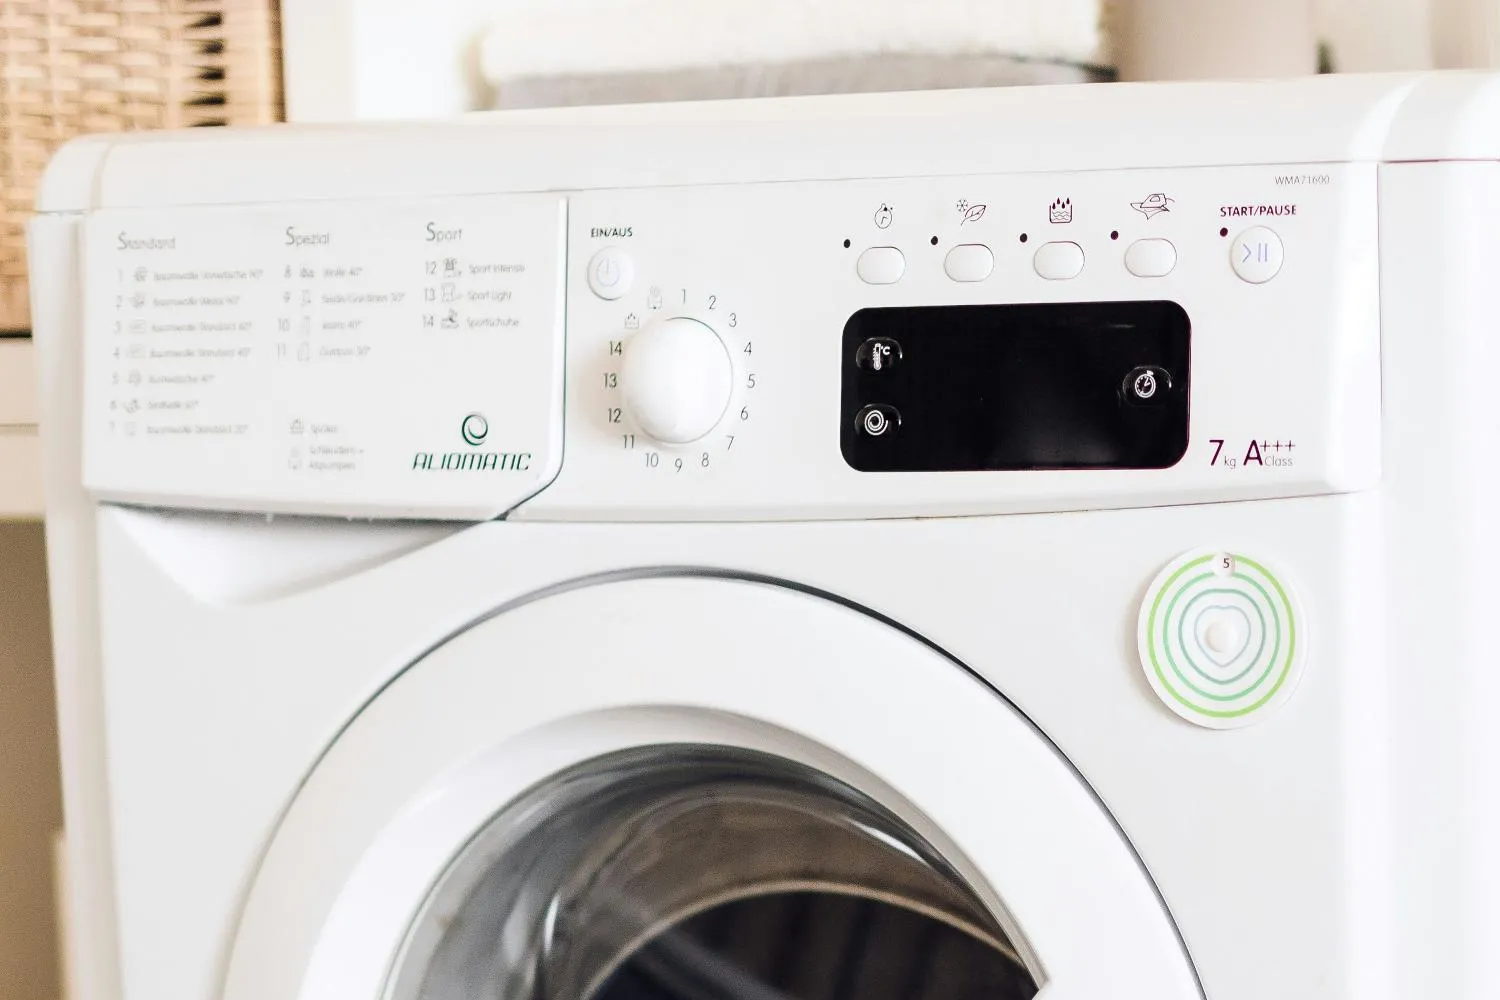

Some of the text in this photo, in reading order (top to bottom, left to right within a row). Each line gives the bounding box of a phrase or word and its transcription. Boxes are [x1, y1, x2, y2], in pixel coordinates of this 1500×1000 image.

[1220, 204, 1297, 217] START/PAUSE
[285, 226, 330, 247] Spezial
[425, 221, 462, 244] Sport
[590, 226, 634, 238] EIN/AUS
[425, 260, 437, 275] 12
[681, 288, 687, 304] 1
[708, 295, 717, 310] 2
[422, 314, 434, 328] 14
[728, 312, 738, 328] 3
[609, 341, 623, 356] 14
[743, 341, 753, 356] 4
[603, 372, 618, 389] 13
[747, 373, 757, 389] 5
[607, 407, 622, 424] 12
[740, 406, 749, 421] 6
[623, 434, 636, 449] 11
[726, 434, 735, 451] 7
[412, 452, 532, 471] ALIOMATIC
[645, 452, 660, 468] 10
[674, 457, 683, 473] 9
[701, 452, 710, 468] 8
[1264, 455, 1294, 468] Class
[1223, 557, 1231, 569] 5
